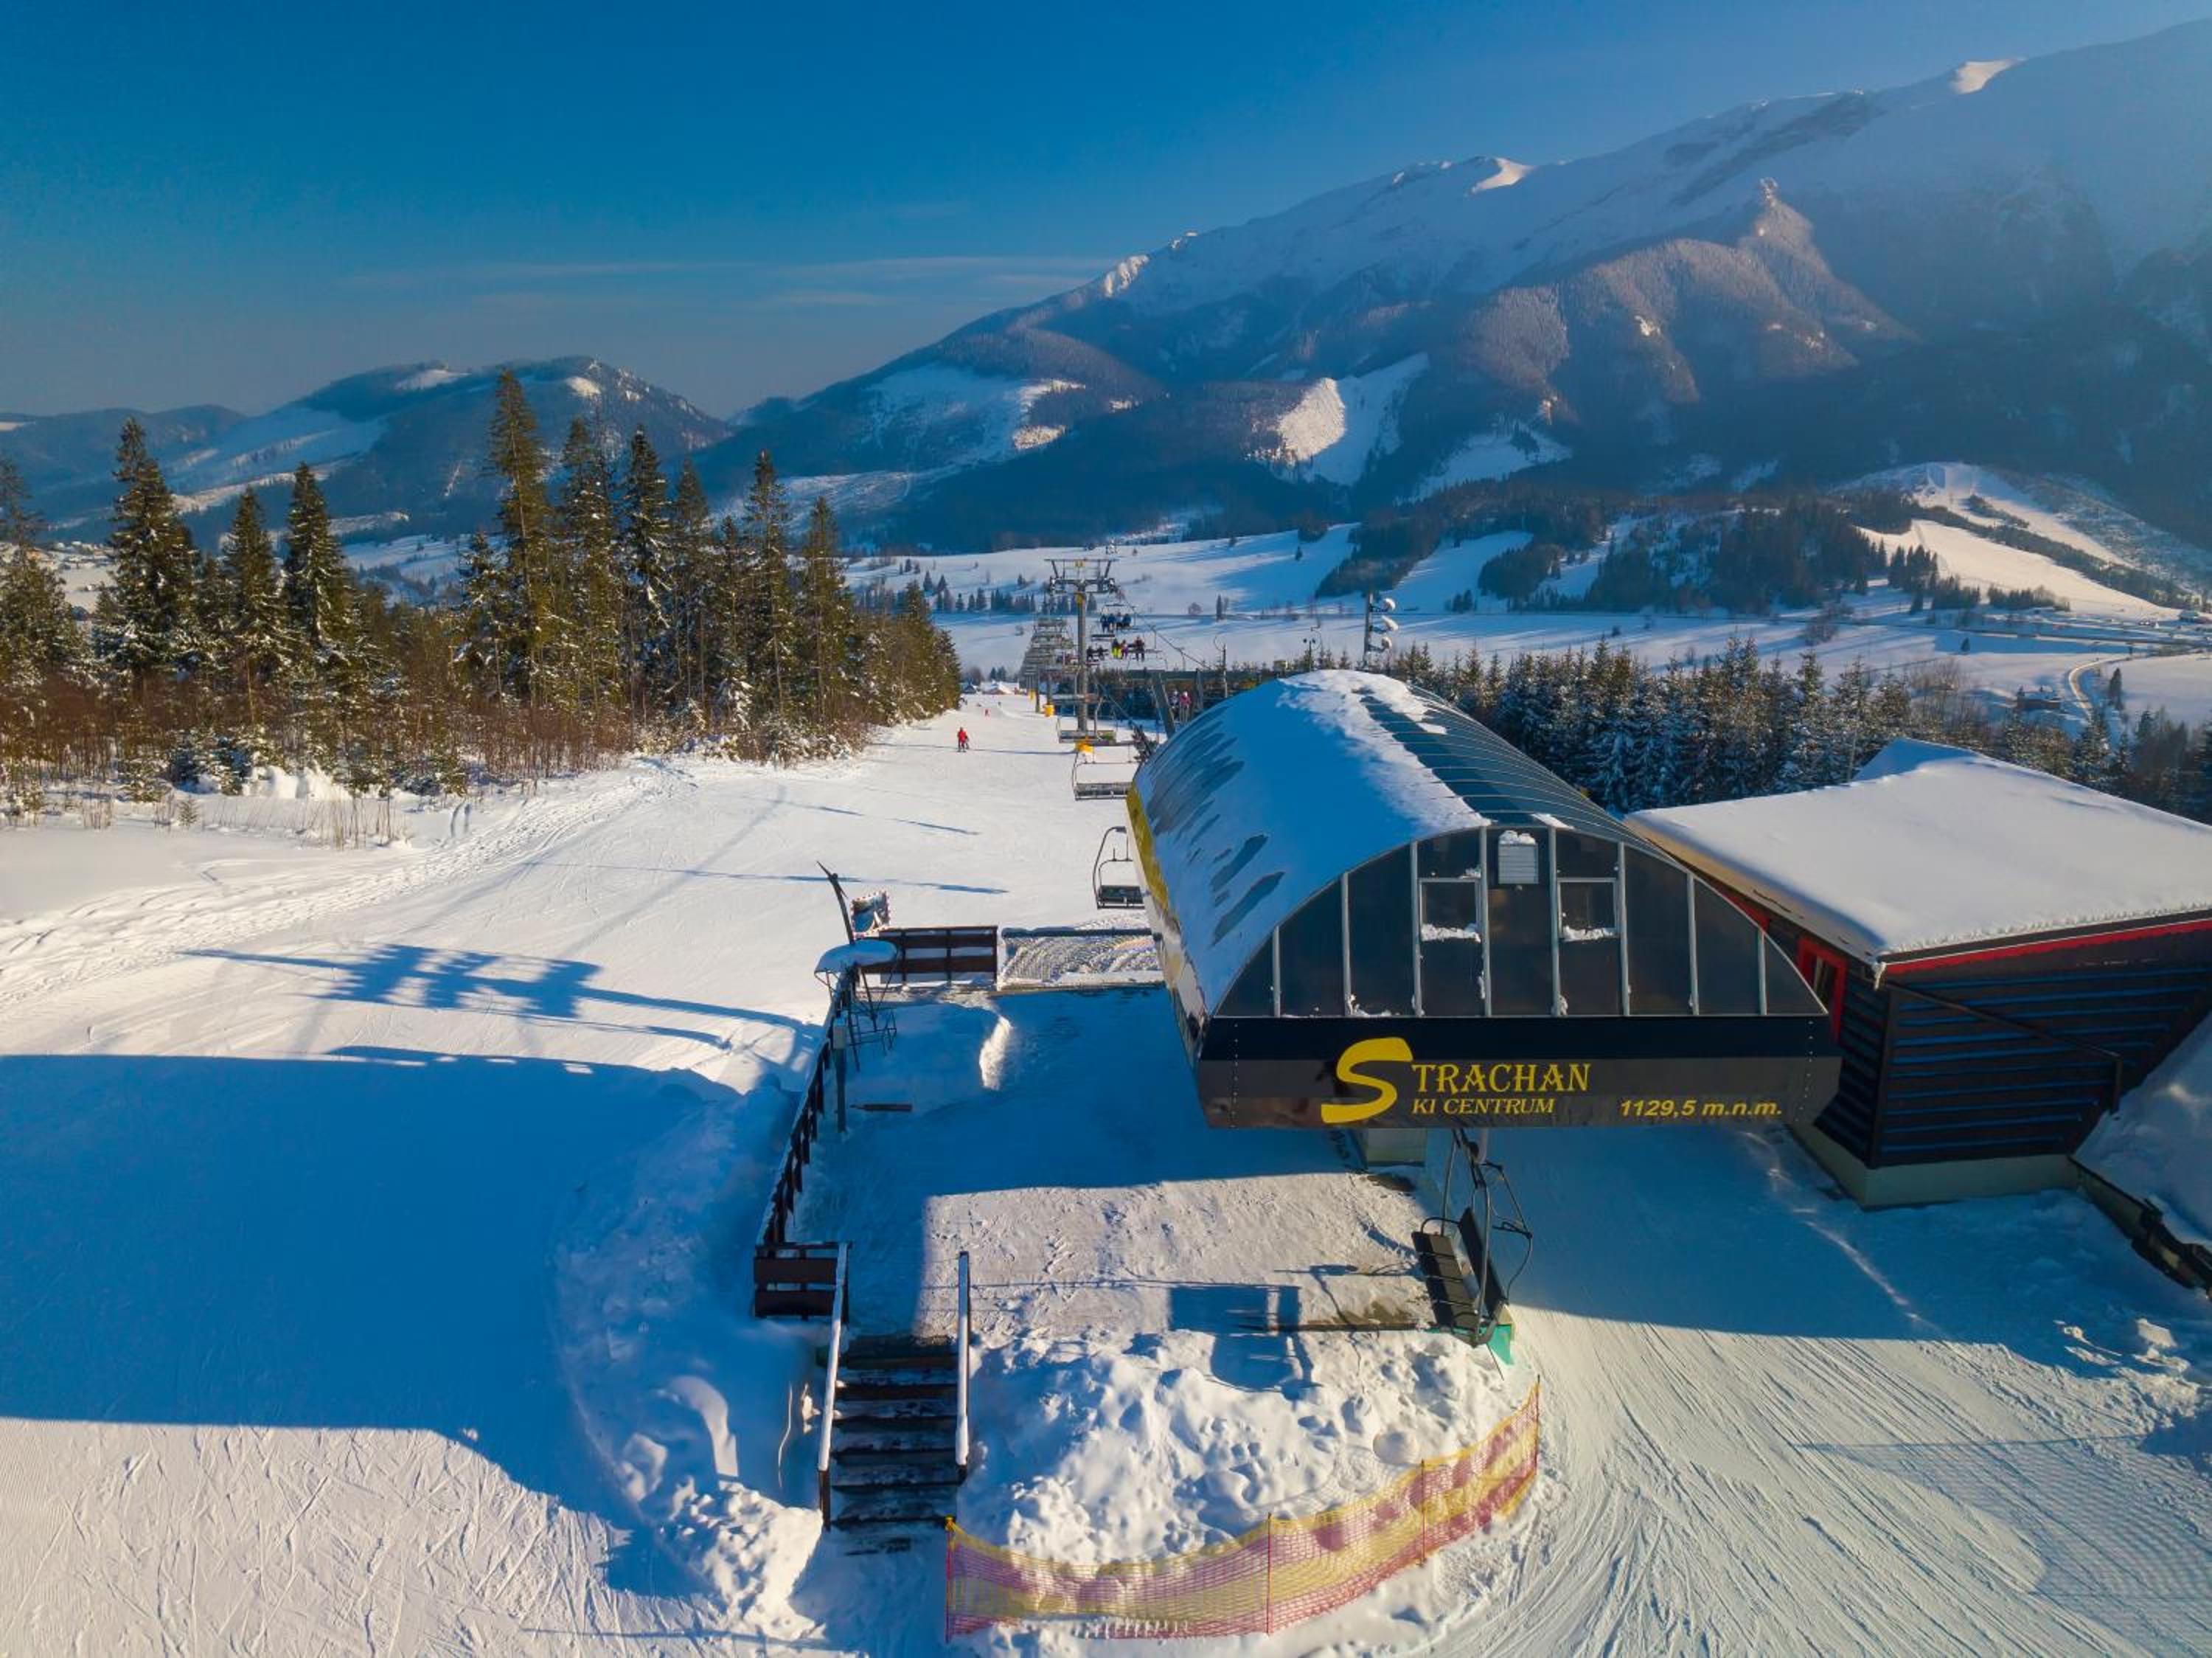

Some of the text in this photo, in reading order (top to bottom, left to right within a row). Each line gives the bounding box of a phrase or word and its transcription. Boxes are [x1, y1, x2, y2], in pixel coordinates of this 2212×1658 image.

[1442, 1097, 1556, 1115] CENTRUM
[1620, 1099, 1783, 1118] 1129,5 m.n.m.
